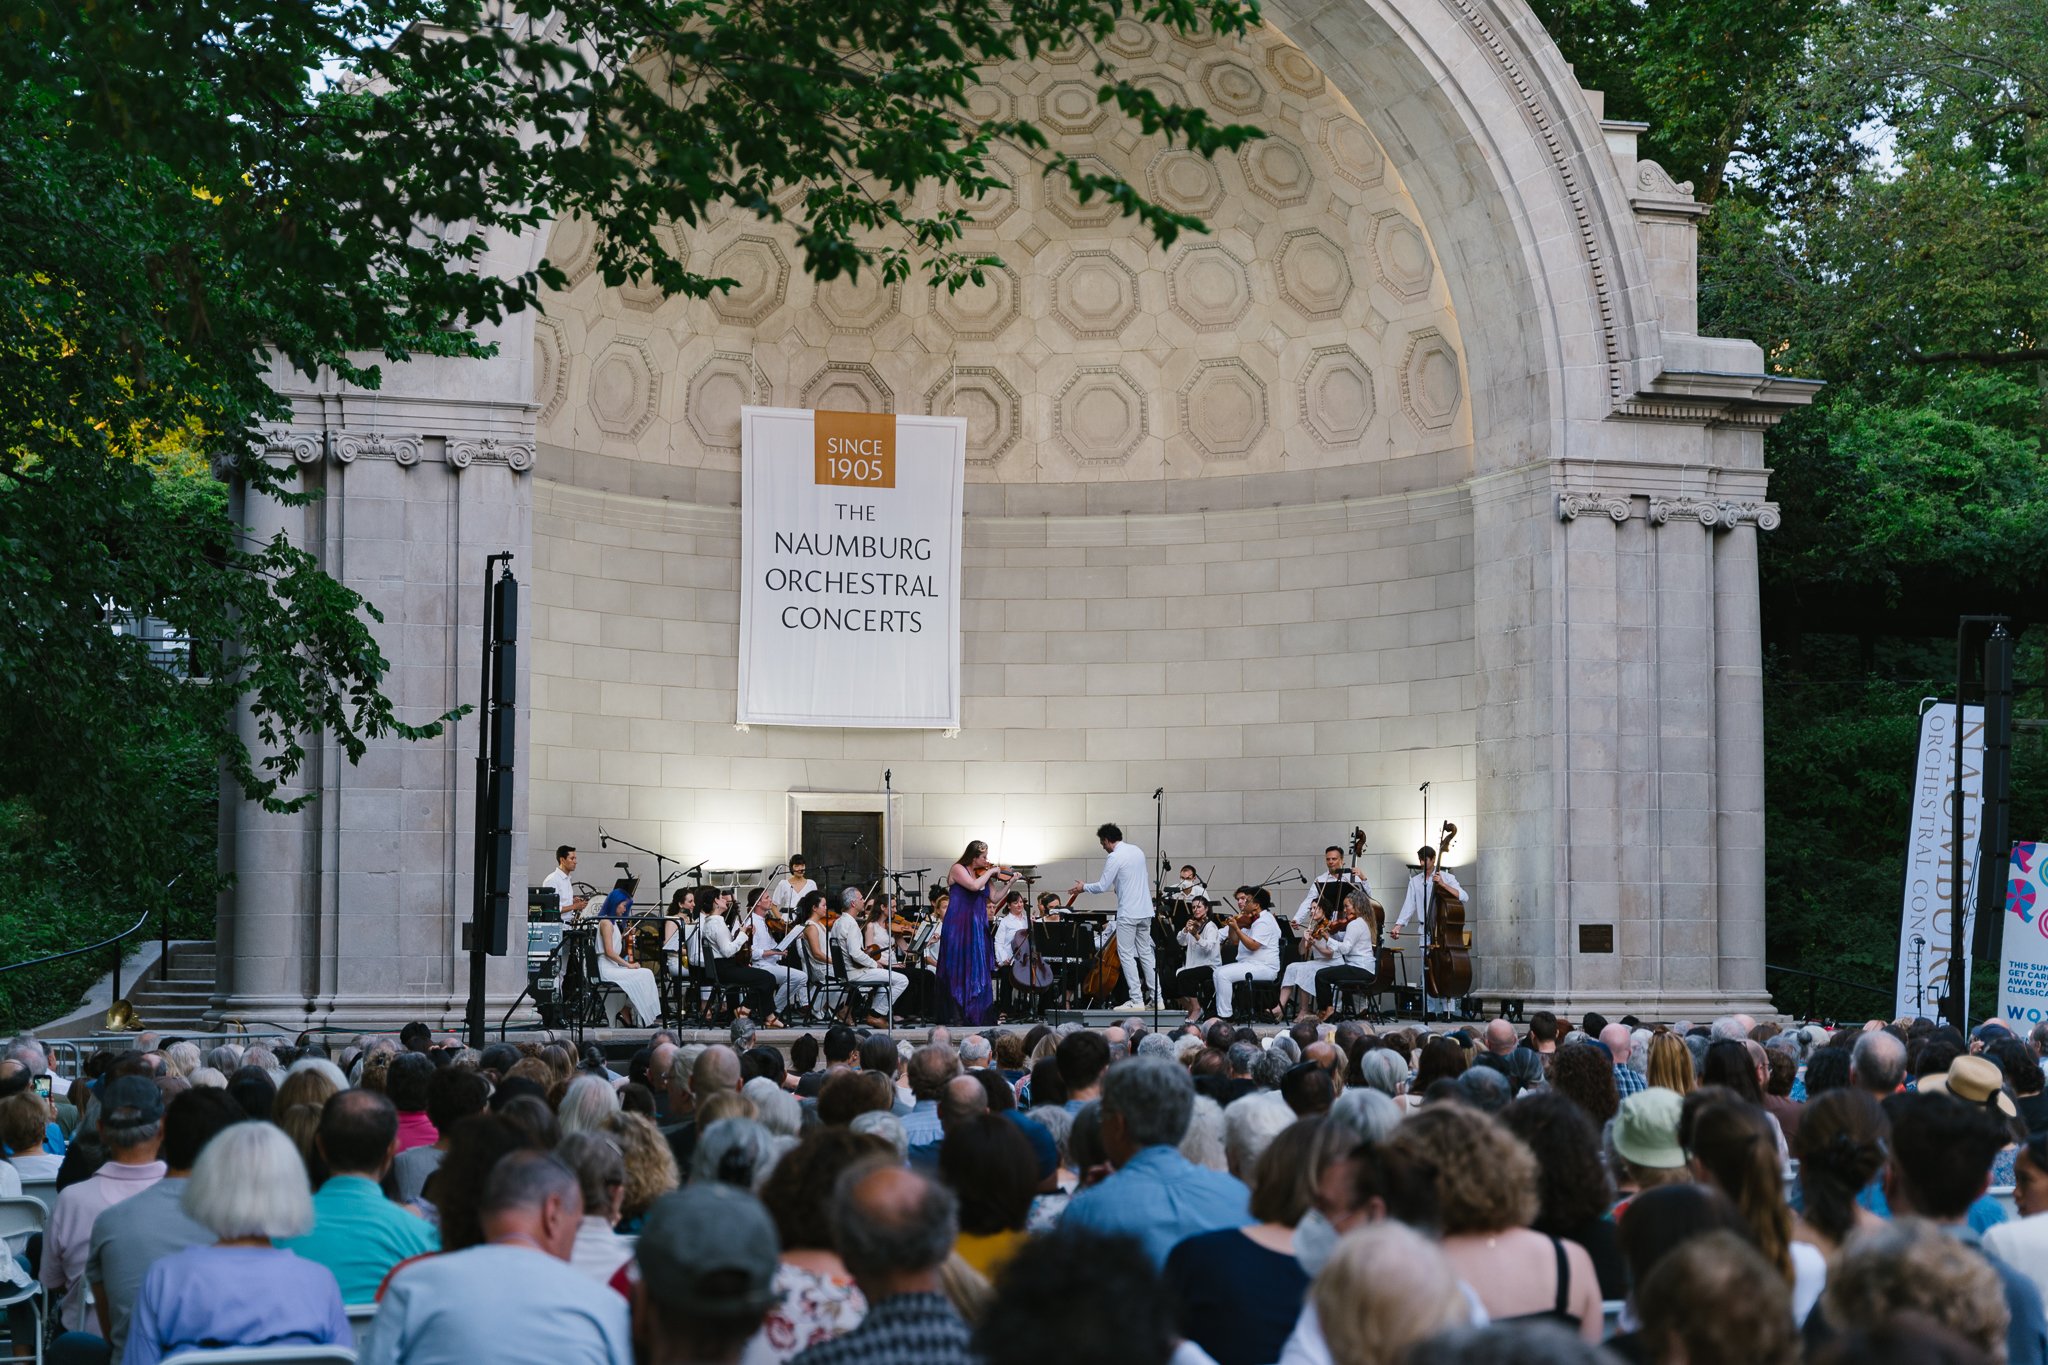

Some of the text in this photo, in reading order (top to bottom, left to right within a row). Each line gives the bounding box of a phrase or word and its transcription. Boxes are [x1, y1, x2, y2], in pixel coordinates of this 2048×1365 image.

[827, 437, 883, 456] SINCE
[828, 458, 883, 480] 1905
[835, 503, 876, 521] THE
[776, 532, 930, 560] NAUMBURG
[765, 568, 939, 598] ORCHESTRAL
[781, 606, 922, 633] CONCERTS
[1915, 715, 1945, 870] ORCHESTRAL
[2008, 969, 2048, 980] GET CAR
[2009, 961, 2028, 970] THIS
[2008, 978, 2047, 989] AWAY BY
[2007, 1004, 2048, 1024] WQ
